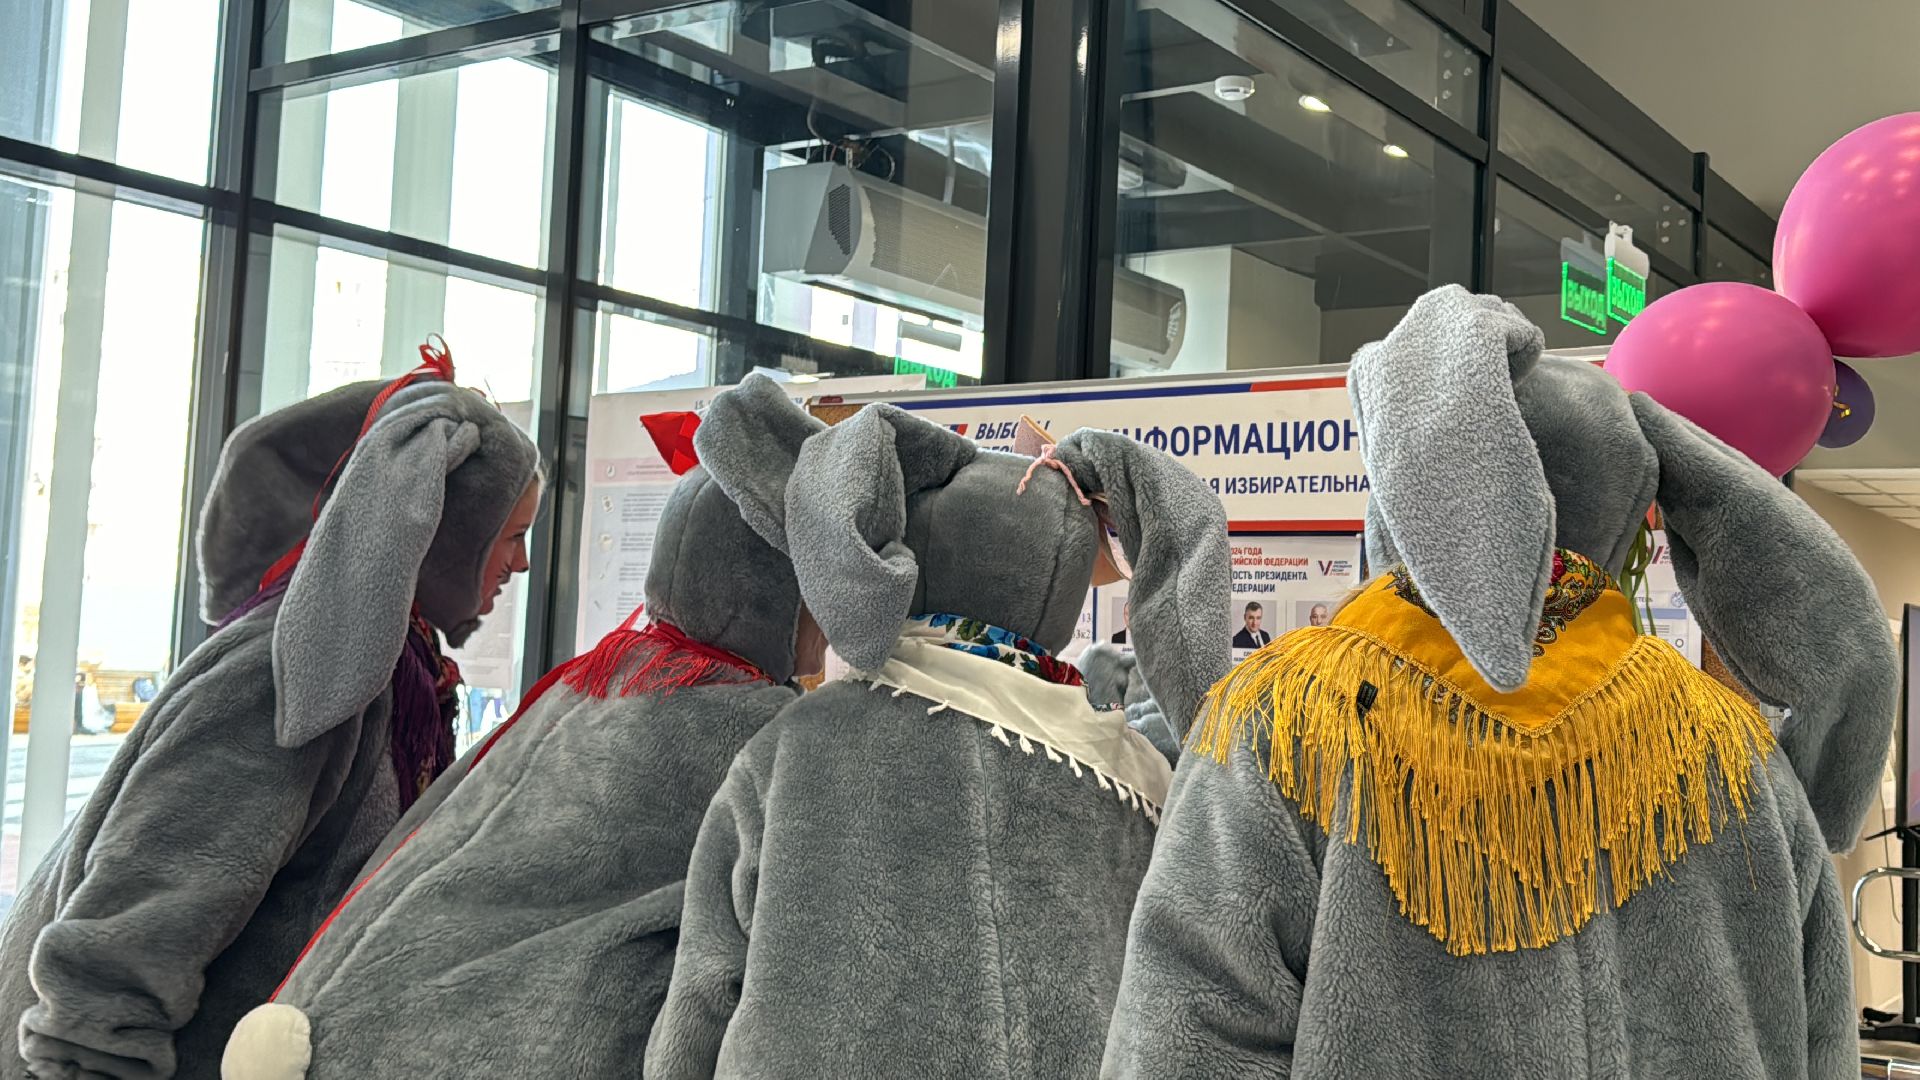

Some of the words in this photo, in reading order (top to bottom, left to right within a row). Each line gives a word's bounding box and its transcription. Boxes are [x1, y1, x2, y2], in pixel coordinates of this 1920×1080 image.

[1225, 475, 1370, 495] ИЗБИРАТЕЛЬНА
[1244, 547, 1263, 556] ГОДА
[1264, 557, 1309, 567] ФЕДЕРАЦИИ
[1254, 570, 1308, 582] ПРЕЗИДЕНТА
